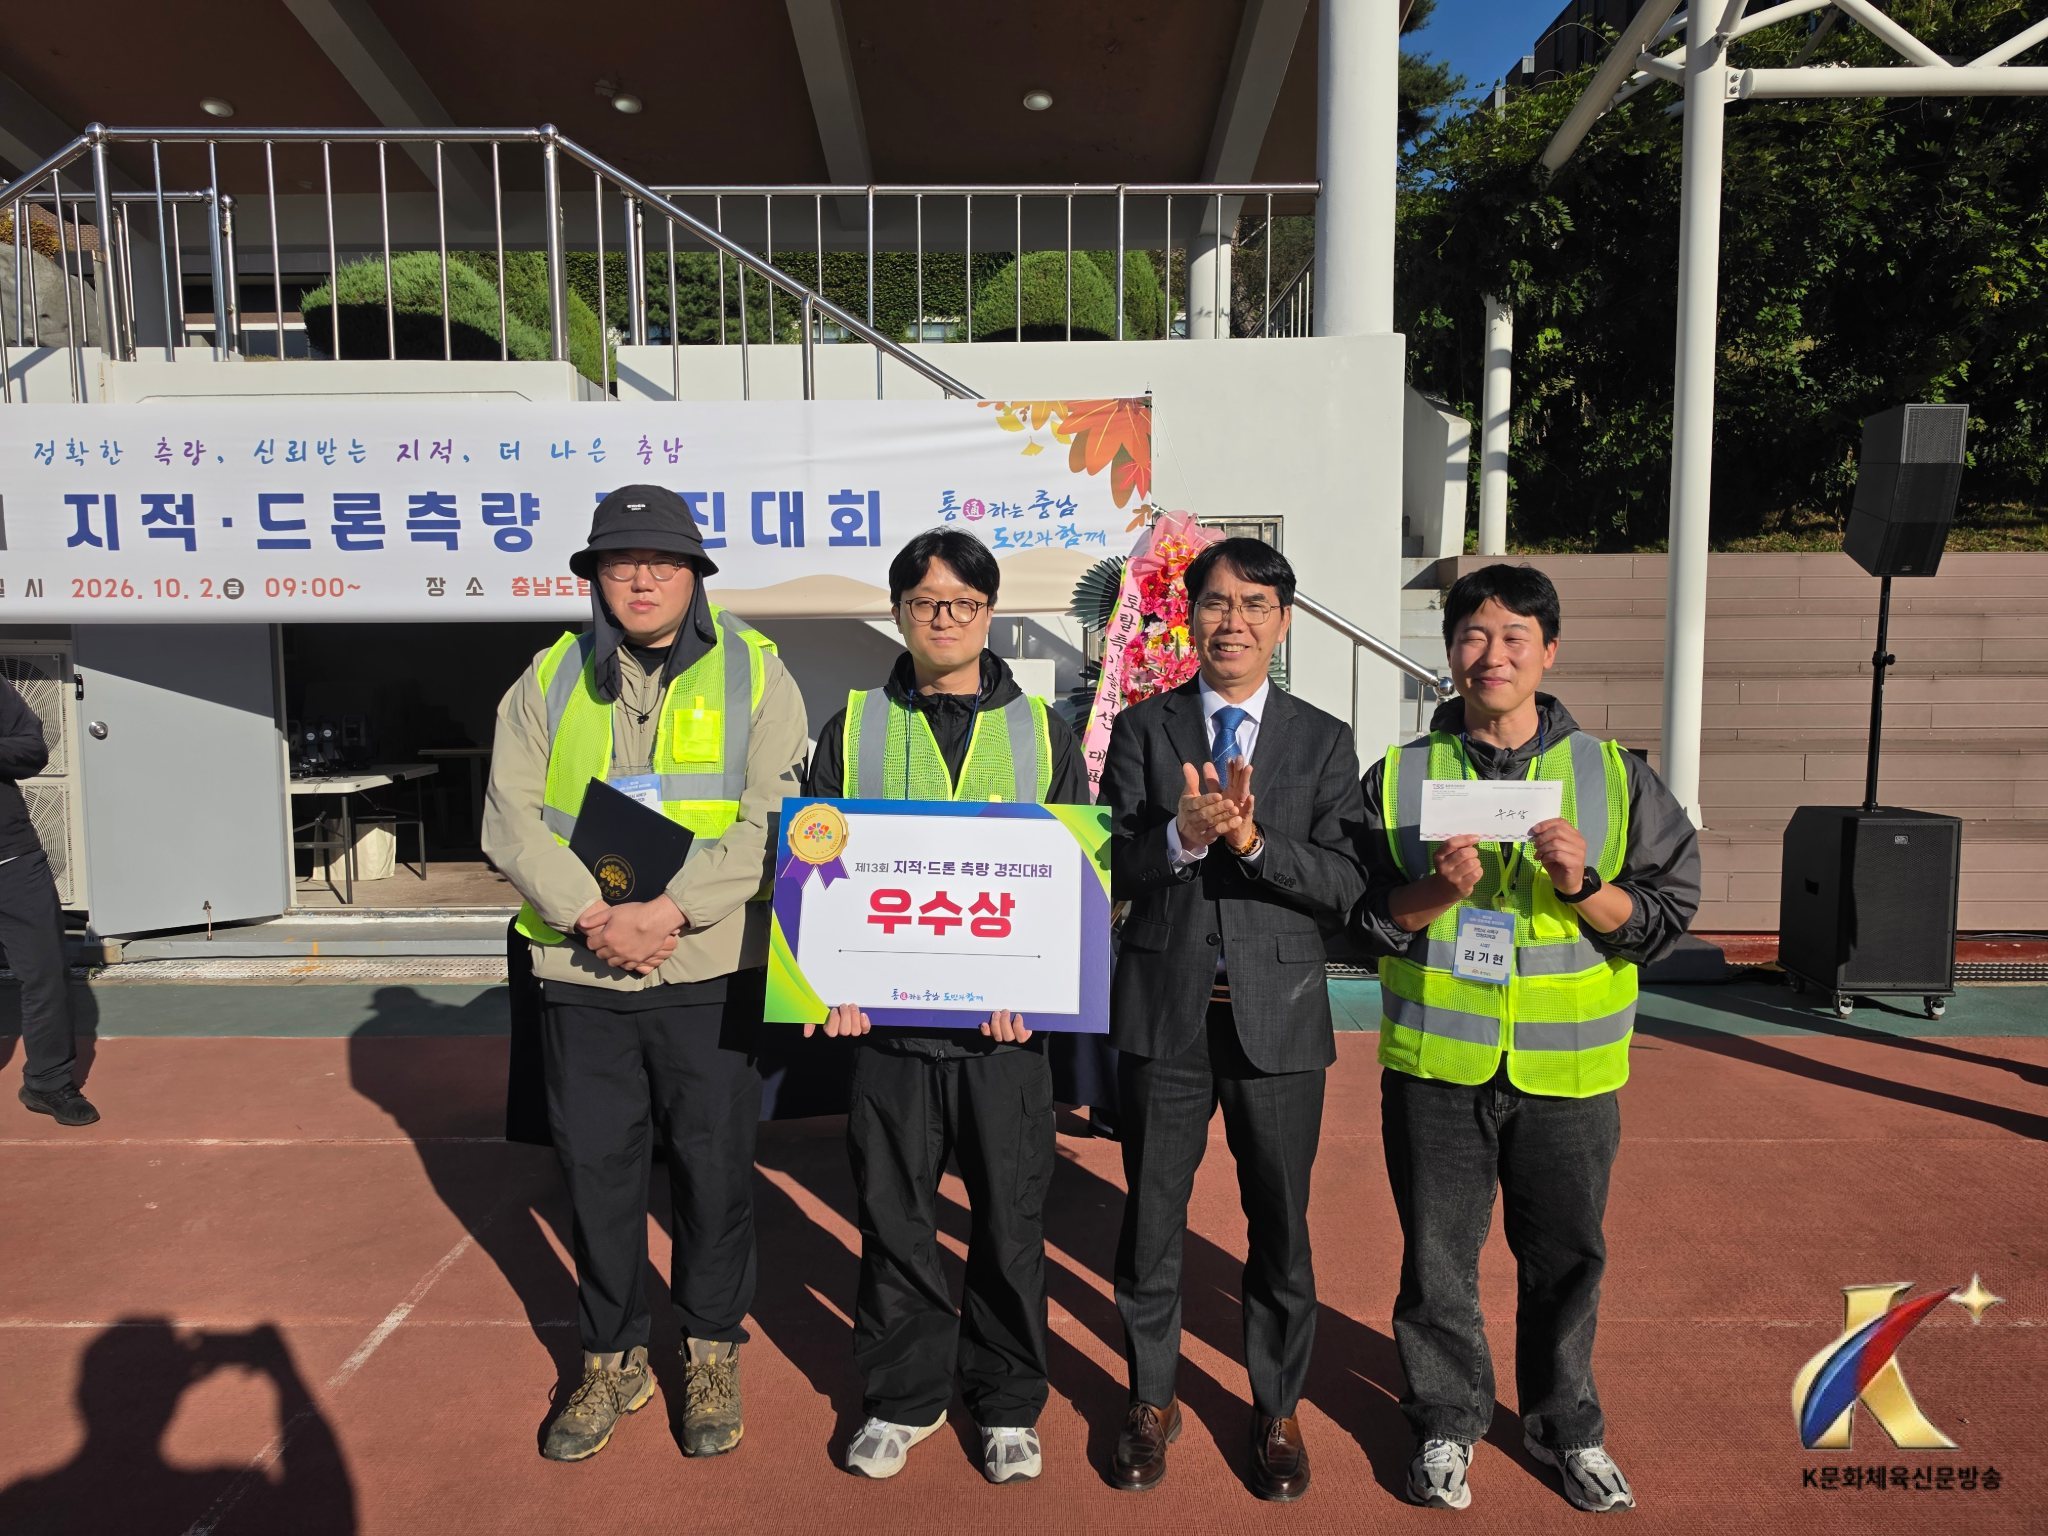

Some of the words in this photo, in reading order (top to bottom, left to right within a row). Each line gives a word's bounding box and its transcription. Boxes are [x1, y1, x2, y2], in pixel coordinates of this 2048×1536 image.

[34, 437, 124, 467] 정확한
[154, 436, 224, 467] 측량,
[254, 437, 367, 466] 신뢰받는
[397, 438, 470, 464] 지적,
[500, 440, 520, 462] 더
[551, 437, 606, 464] 나은
[637, 435, 684, 465] 충남
[64, 490, 541, 553] 지적·드론측량
[595, 488, 882, 551] 진대회
[992, 526, 1053, 549] 도민과
[1055, 523, 1107, 549] 함께
[72, 578, 143, 599] 2026.
[154, 578, 189, 599] 10.
[265, 577, 361, 598] 09:00~
[1494, 808, 1529, 820] 우수상
[855, 862, 889, 873] 제13회
[893, 860, 956, 876] 지적·드론
[960, 861, 990, 877] 측량
[994, 862, 1052, 878] 경진대회
[866, 888, 1015, 938] 우수상
